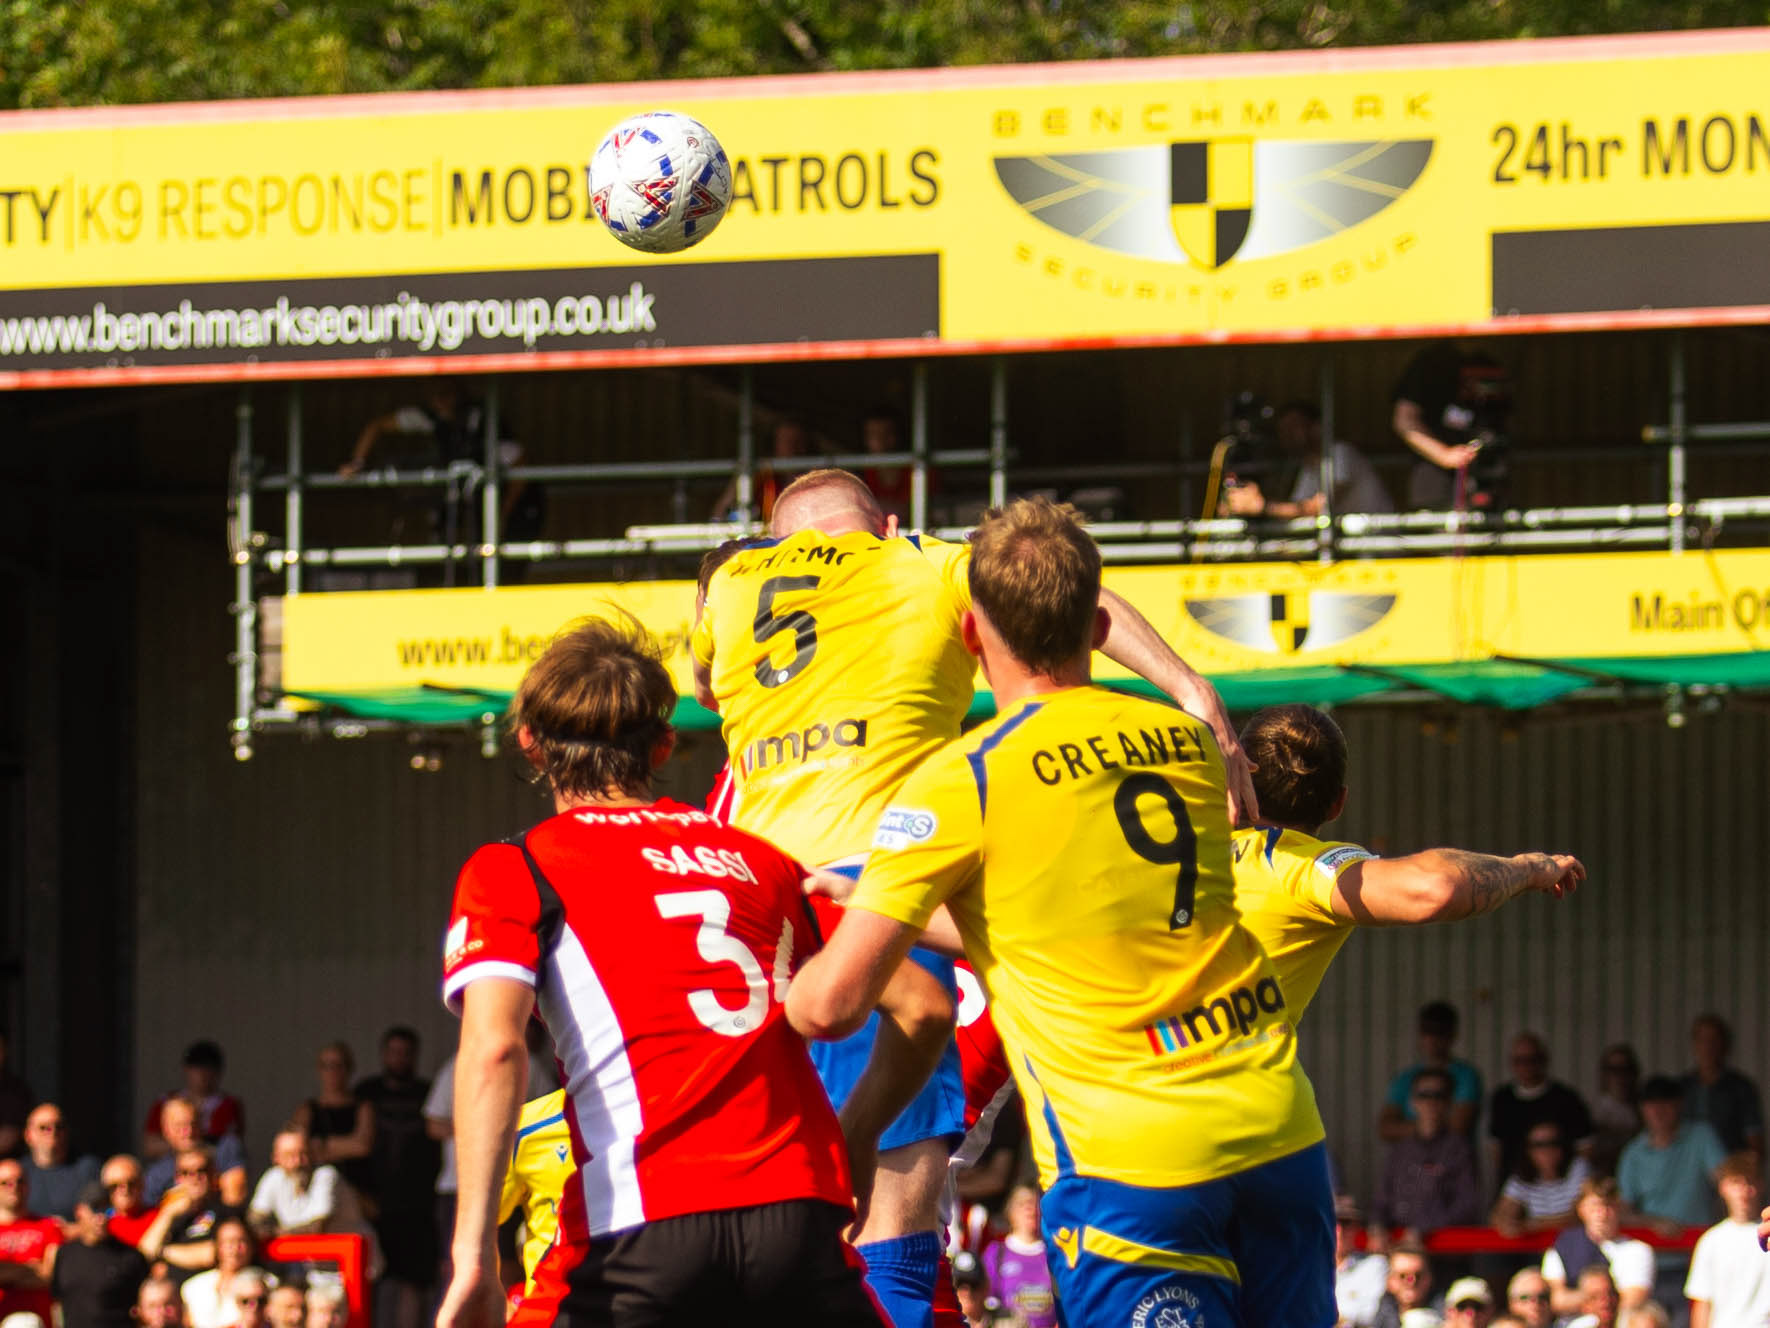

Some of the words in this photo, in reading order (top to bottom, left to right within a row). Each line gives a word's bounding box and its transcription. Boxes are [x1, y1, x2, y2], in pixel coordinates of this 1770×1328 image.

[991, 91, 1435, 138] BENCHMARK
[1492, 123, 1623, 184] 24hr
[78, 180, 143, 242] K9
[159, 168, 427, 240] RESPONSE
[0, 281, 657, 356] www.benchmarksecuritygroup.co.uk
[752, 574, 818, 689] 5
[1630, 590, 1725, 634] Main
[756, 718, 868, 770] mpa
[1031, 725, 1208, 786] CREANEY
[640, 844, 760, 886] SASSI
[1113, 770, 1199, 932] 9
[1182, 976, 1286, 1043] mpa
[1154, 1286, 1201, 1310] LYONS
